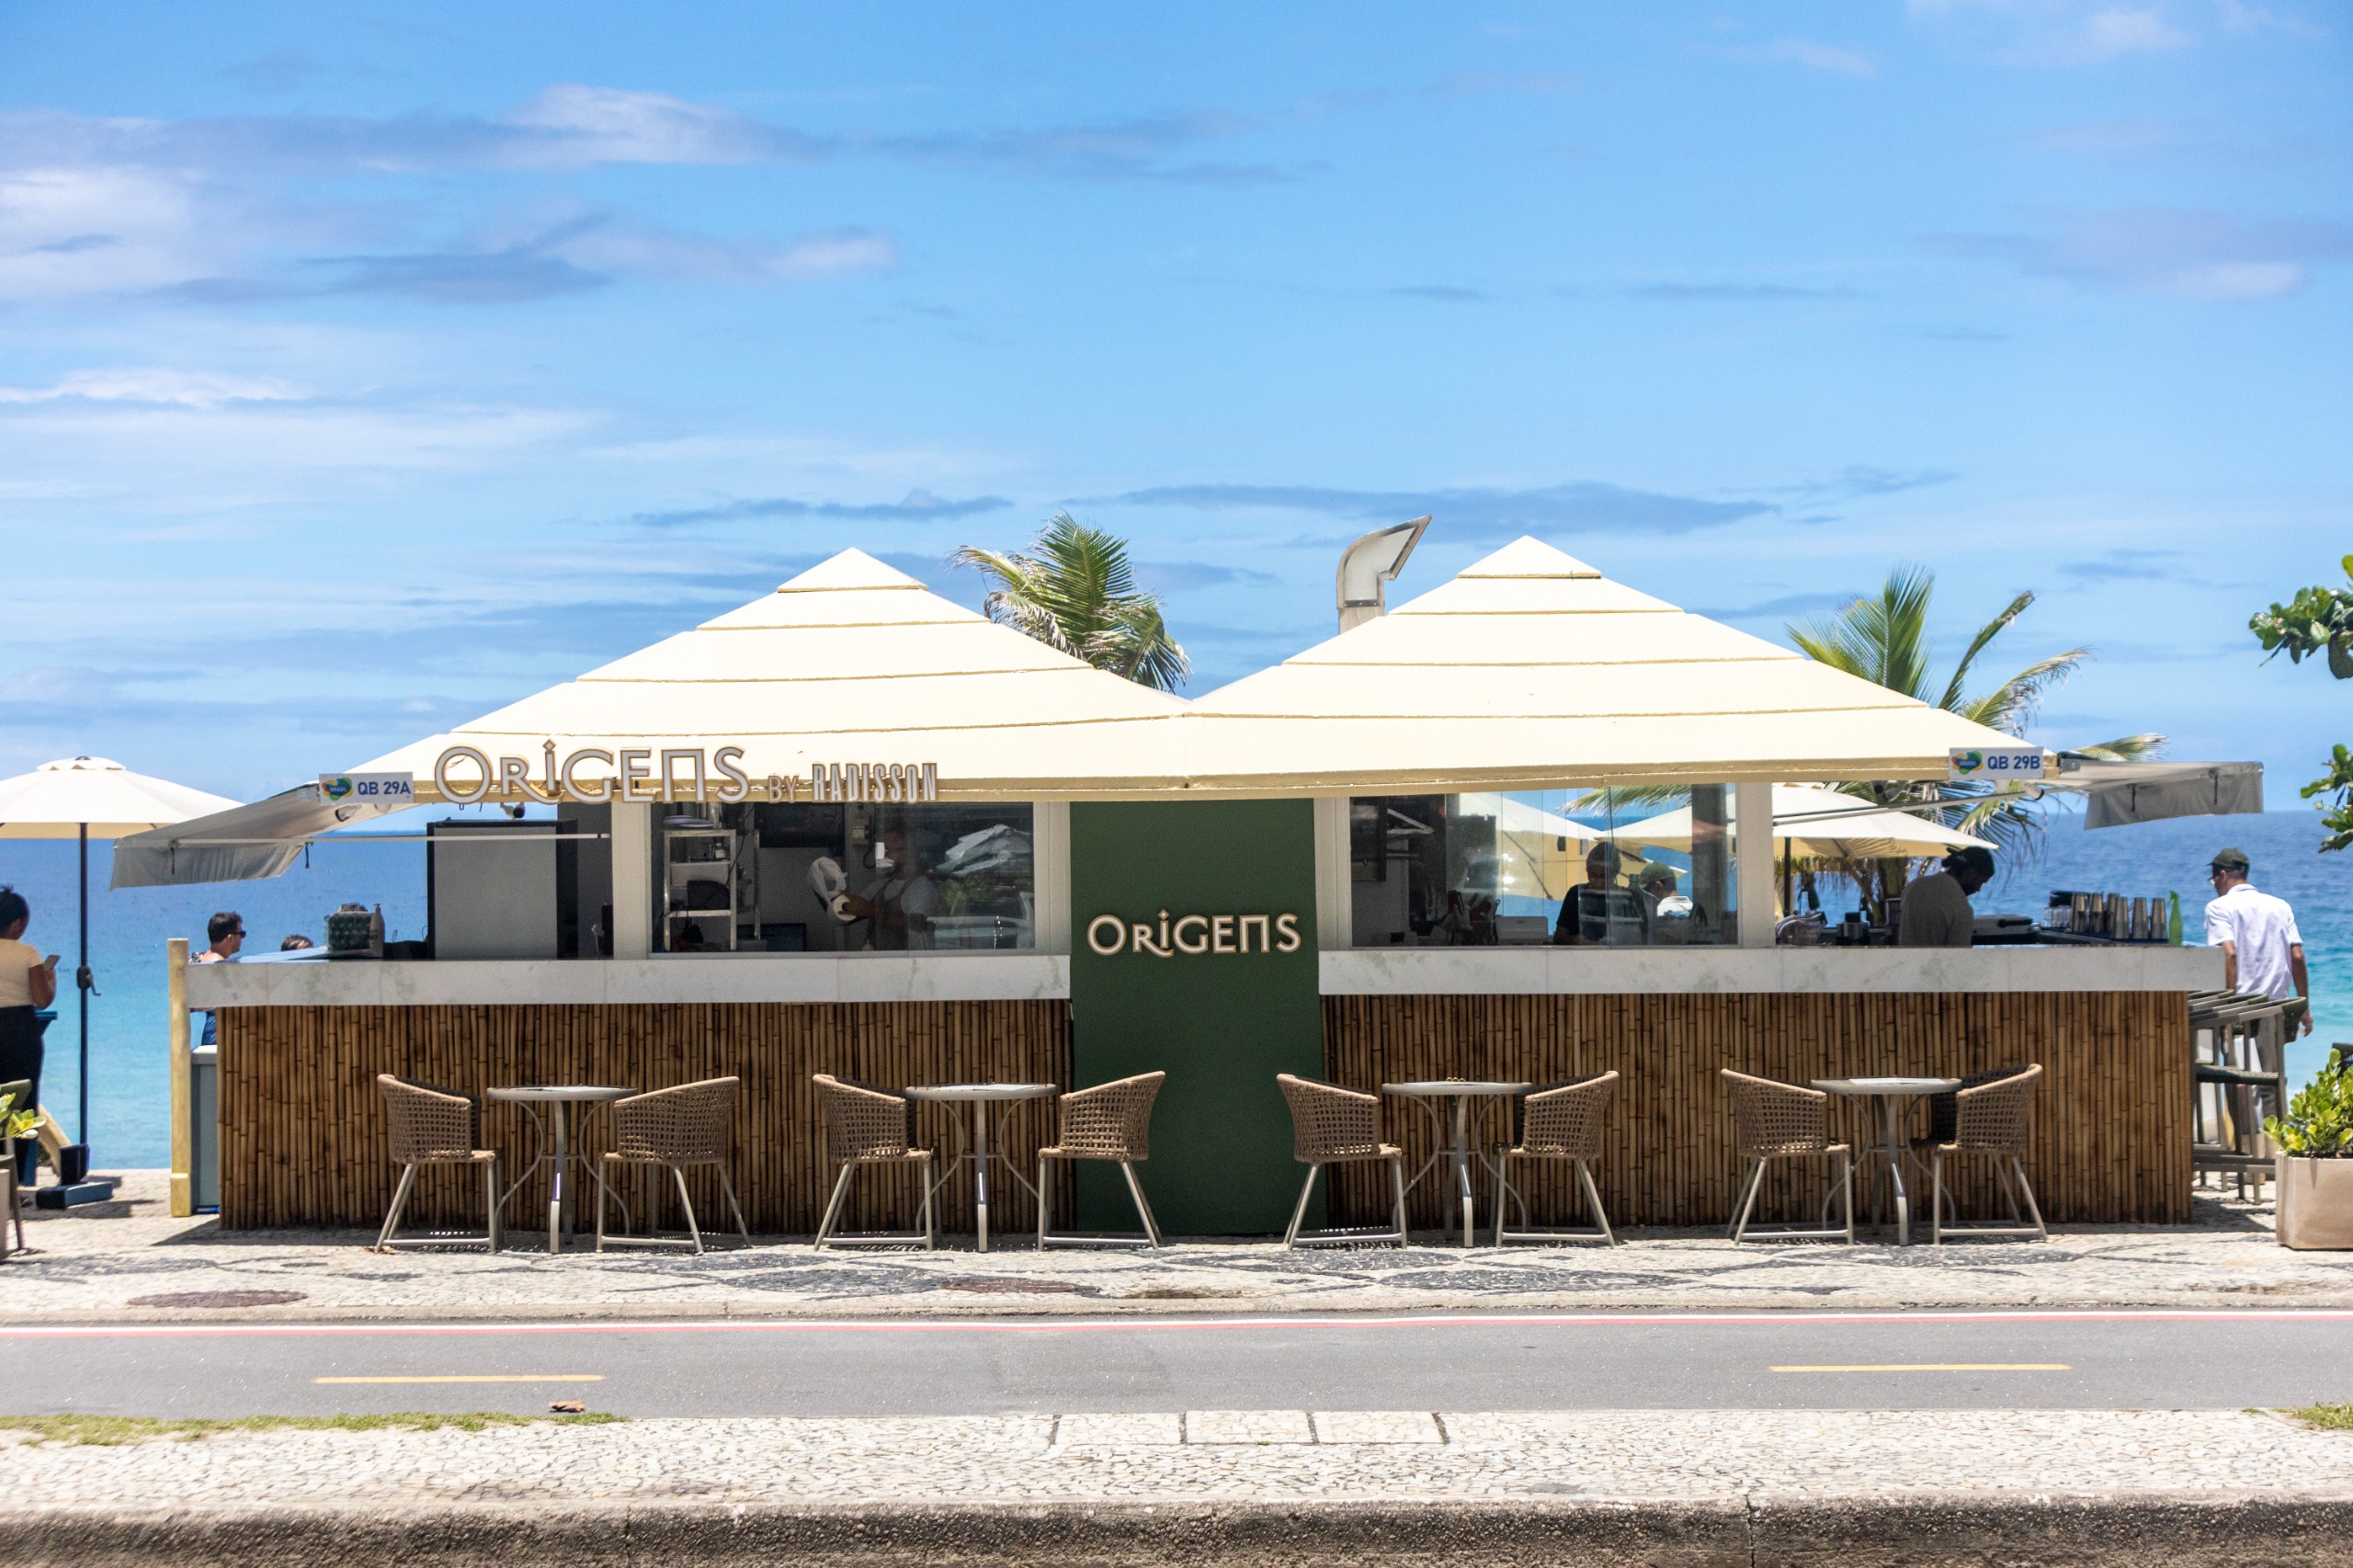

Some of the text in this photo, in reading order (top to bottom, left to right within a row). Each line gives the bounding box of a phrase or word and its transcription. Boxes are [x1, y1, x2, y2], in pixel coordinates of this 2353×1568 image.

[1987, 755, 2040, 769] QB 29B
[358, 780, 411, 795] QB 29A
[767, 775, 799, 802] BY
[812, 762, 938, 803] RADISSON
